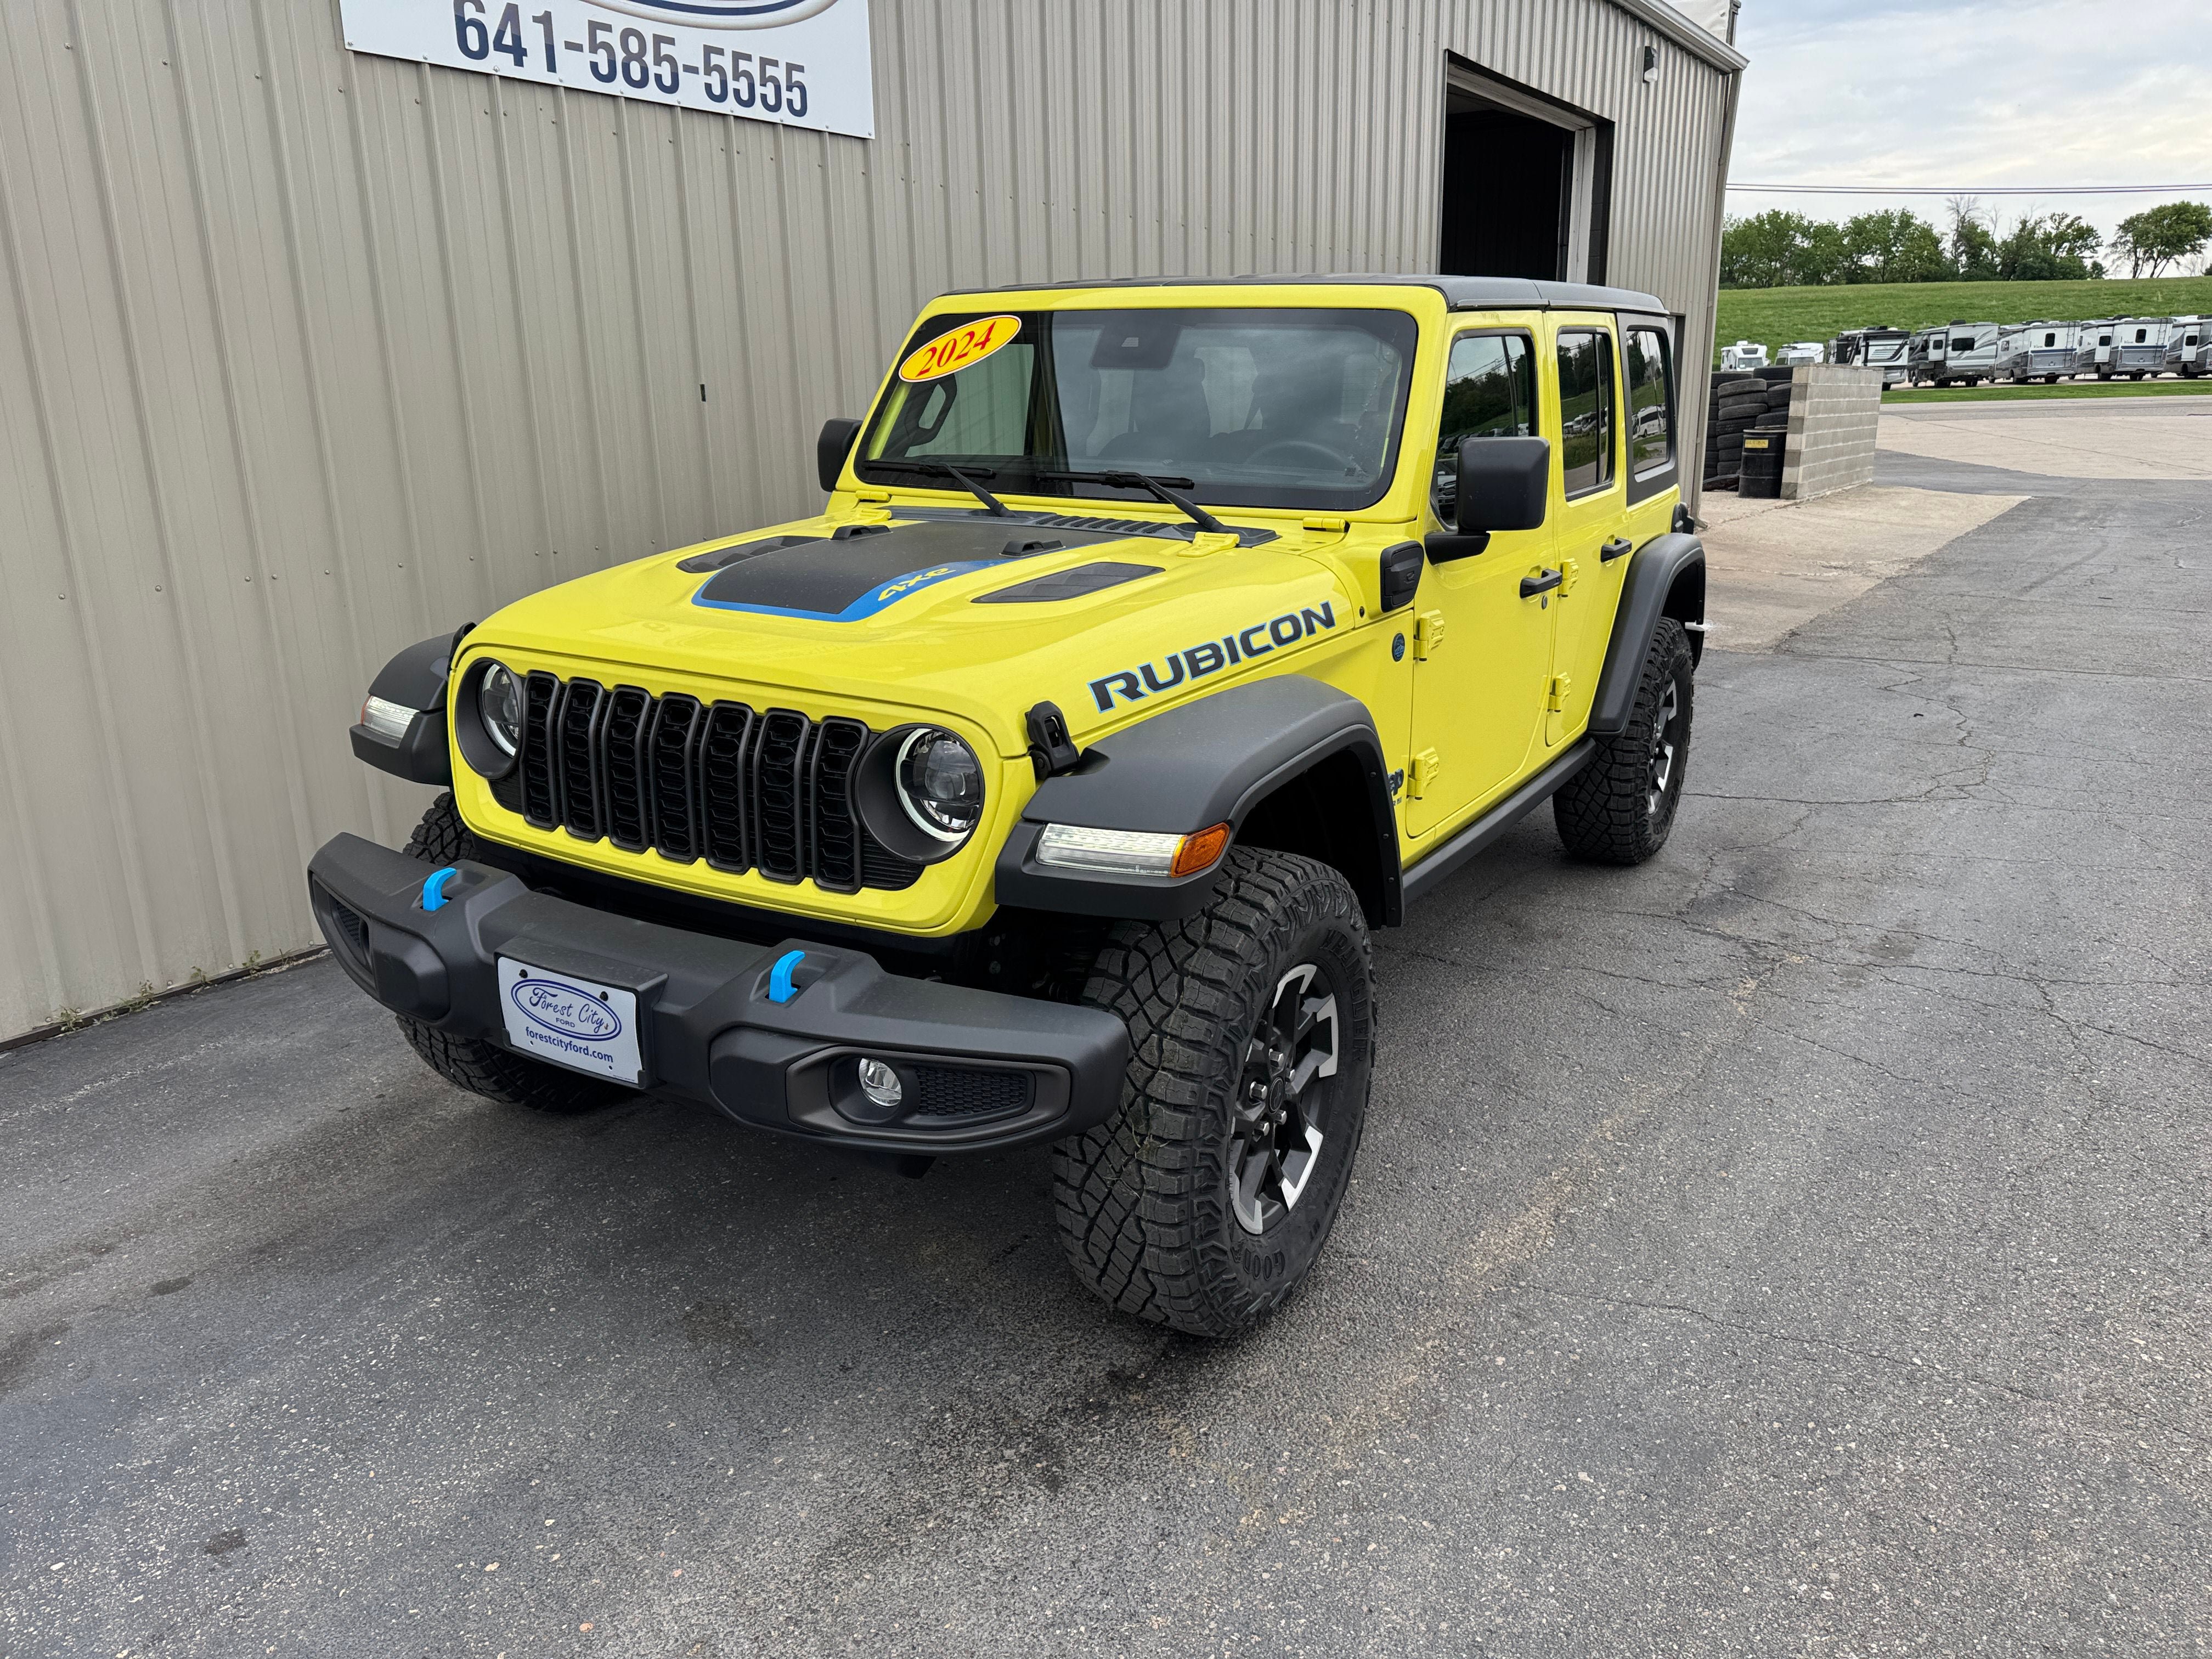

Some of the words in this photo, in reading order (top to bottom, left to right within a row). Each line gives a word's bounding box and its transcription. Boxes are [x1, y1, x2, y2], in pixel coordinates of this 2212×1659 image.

[454, 0, 809, 118] 641-585-5555
[915, 320, 996, 378] 2024
[878, 567, 956, 601] 4xe
[1088, 600, 1336, 714] RUBICON
[529, 987, 574, 1017] Forest
[578, 1003, 604, 1034] City
[556, 1018, 575, 1028] FORD
[525, 1026, 614, 1063] forestcityford.com
